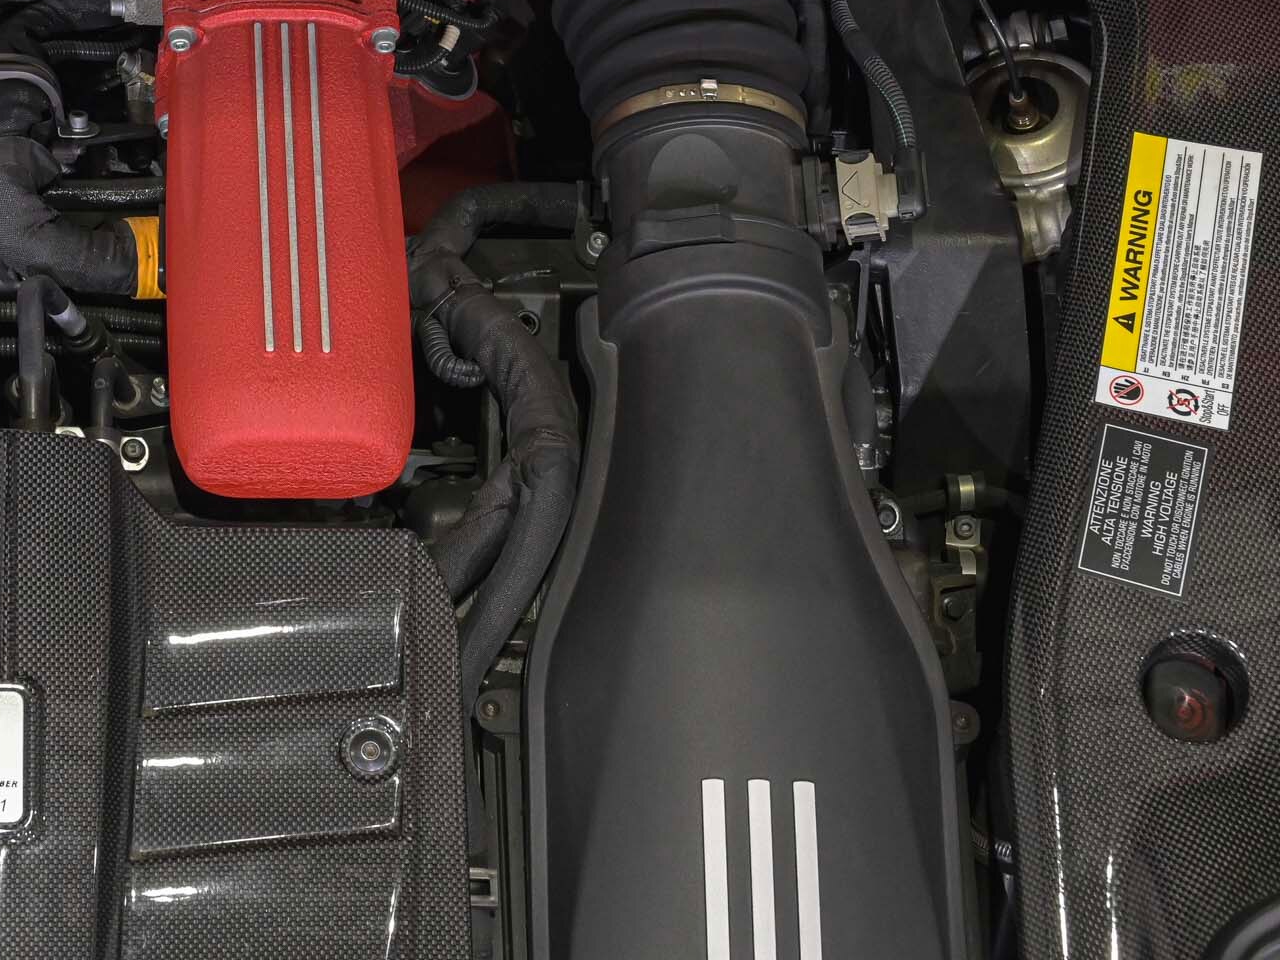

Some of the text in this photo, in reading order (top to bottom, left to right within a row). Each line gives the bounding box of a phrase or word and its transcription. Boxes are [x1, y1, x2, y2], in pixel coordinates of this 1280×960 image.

[1119, 190, 1152, 301] WARNING
[1169, 280, 1177, 299] SYSTEM
[1165, 299, 1174, 328] STOP&START
[1160, 339, 1169, 366] DEACTIVATE
[1199, 389, 1215, 424] Stop&Start
[1216, 403, 1229, 416] OFF
[1133, 440, 1143, 455] CAVI
[1125, 461, 1139, 495] STACCARE
[1188, 461, 1201, 492] RUNNING
[1089, 459, 1113, 534] ATTENZIONE
[1101, 456, 1128, 545] ALTA TENSIONE
[1120, 443, 1152, 570] D'ACCENSIONE CON MOTORE IN MOTO
[1122, 496, 1132, 512] NON
[1140, 481, 1161, 537] WARNING
[1152, 472, 1178, 556] HIGH VOLTAGE
[1161, 450, 1194, 585] DO NOT TOUCH OR DISCONNECT IGNITION
[1182, 502, 1194, 528] ENGINE
[1114, 519, 1128, 550] TOCCARE
[1177, 529, 1189, 550] WHEN
[1111, 552, 1122, 568] NON
[1172, 552, 1184, 579] CABLES
